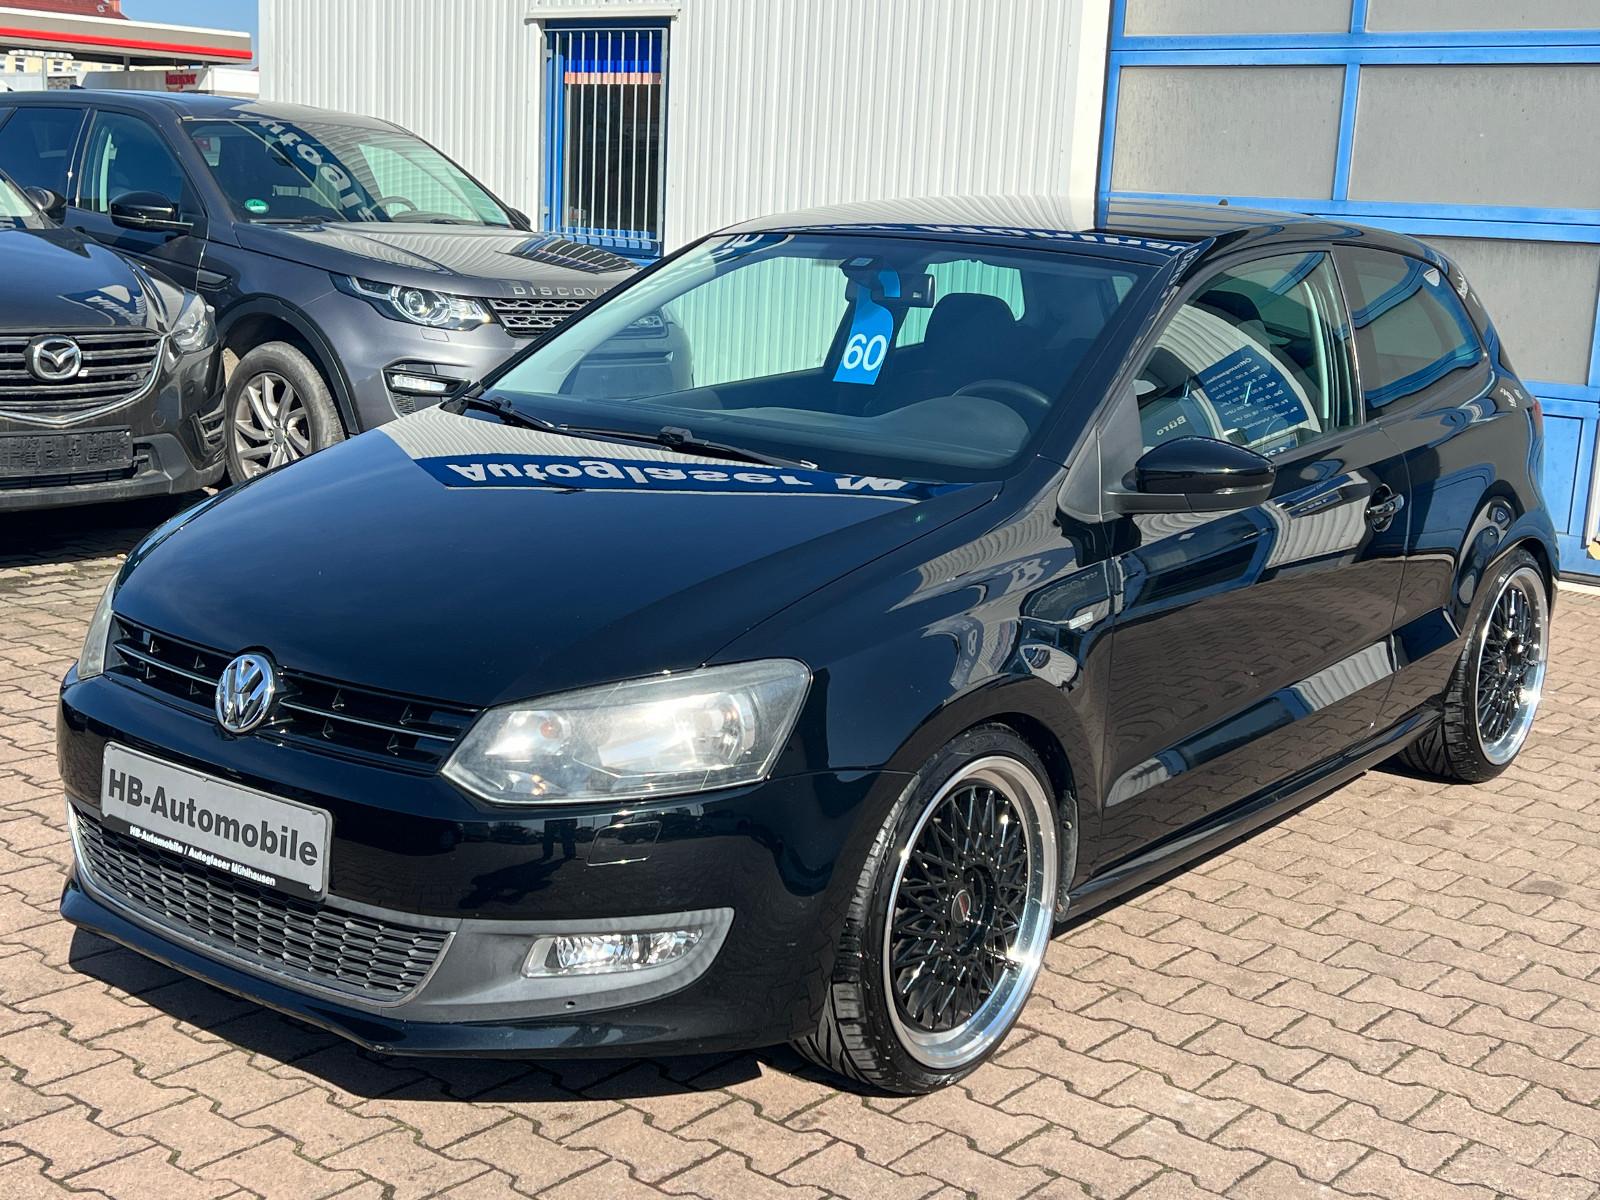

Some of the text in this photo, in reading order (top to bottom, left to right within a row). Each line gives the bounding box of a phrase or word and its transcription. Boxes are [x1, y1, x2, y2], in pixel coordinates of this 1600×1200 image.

[843, 333, 887, 372] 60
[107, 768, 318, 867] HB-Automobile
[129, 825, 184, 854] HB-Automobile
[188, 847, 231, 872] Autoglaser
[231, 862, 276, 887] Mühlhausen
